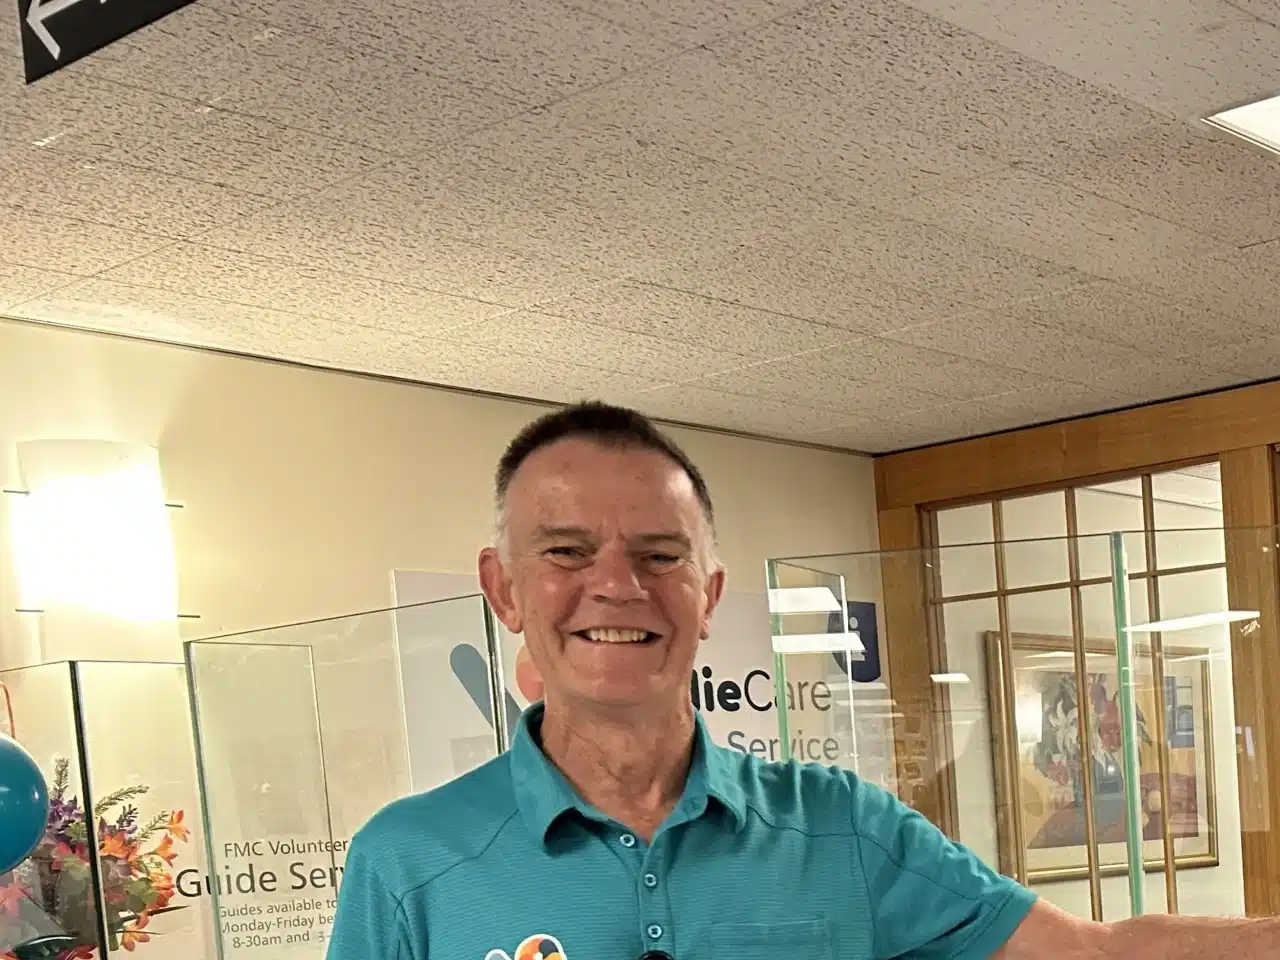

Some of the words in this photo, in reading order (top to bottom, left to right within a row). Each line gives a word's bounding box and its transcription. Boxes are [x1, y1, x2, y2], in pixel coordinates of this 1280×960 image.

[225, 841, 264, 858] FMC
[268, 839, 349, 856] Volunteer
[175, 863, 278, 898] Guide
[220, 905, 263, 918] Guides
[267, 899, 322, 915] available
[222, 914, 315, 933] Monday-Friday
[232, 935, 282, 949] 8-30am
[287, 931, 310, 943] and
